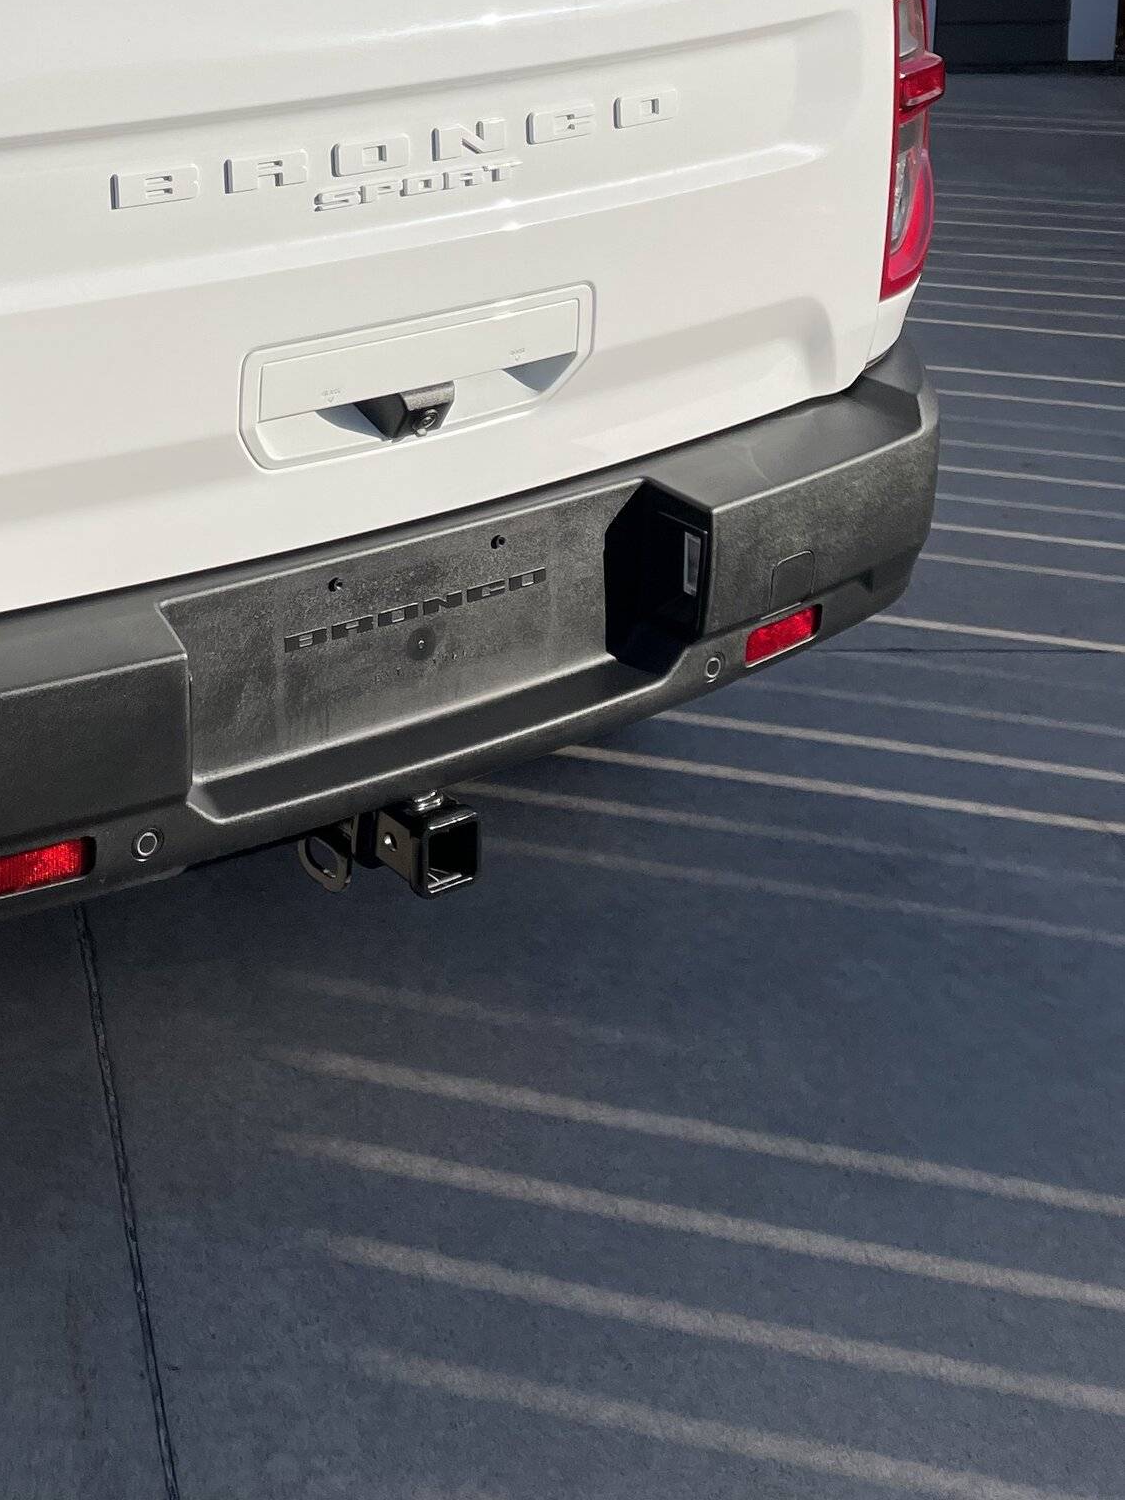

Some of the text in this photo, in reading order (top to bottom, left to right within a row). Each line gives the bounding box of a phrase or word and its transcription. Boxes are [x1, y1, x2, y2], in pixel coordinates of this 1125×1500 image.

[110, 89, 677, 211] BRONCO
[313, 159, 525, 212] SPORT
[283, 566, 547, 653] BRONCO
